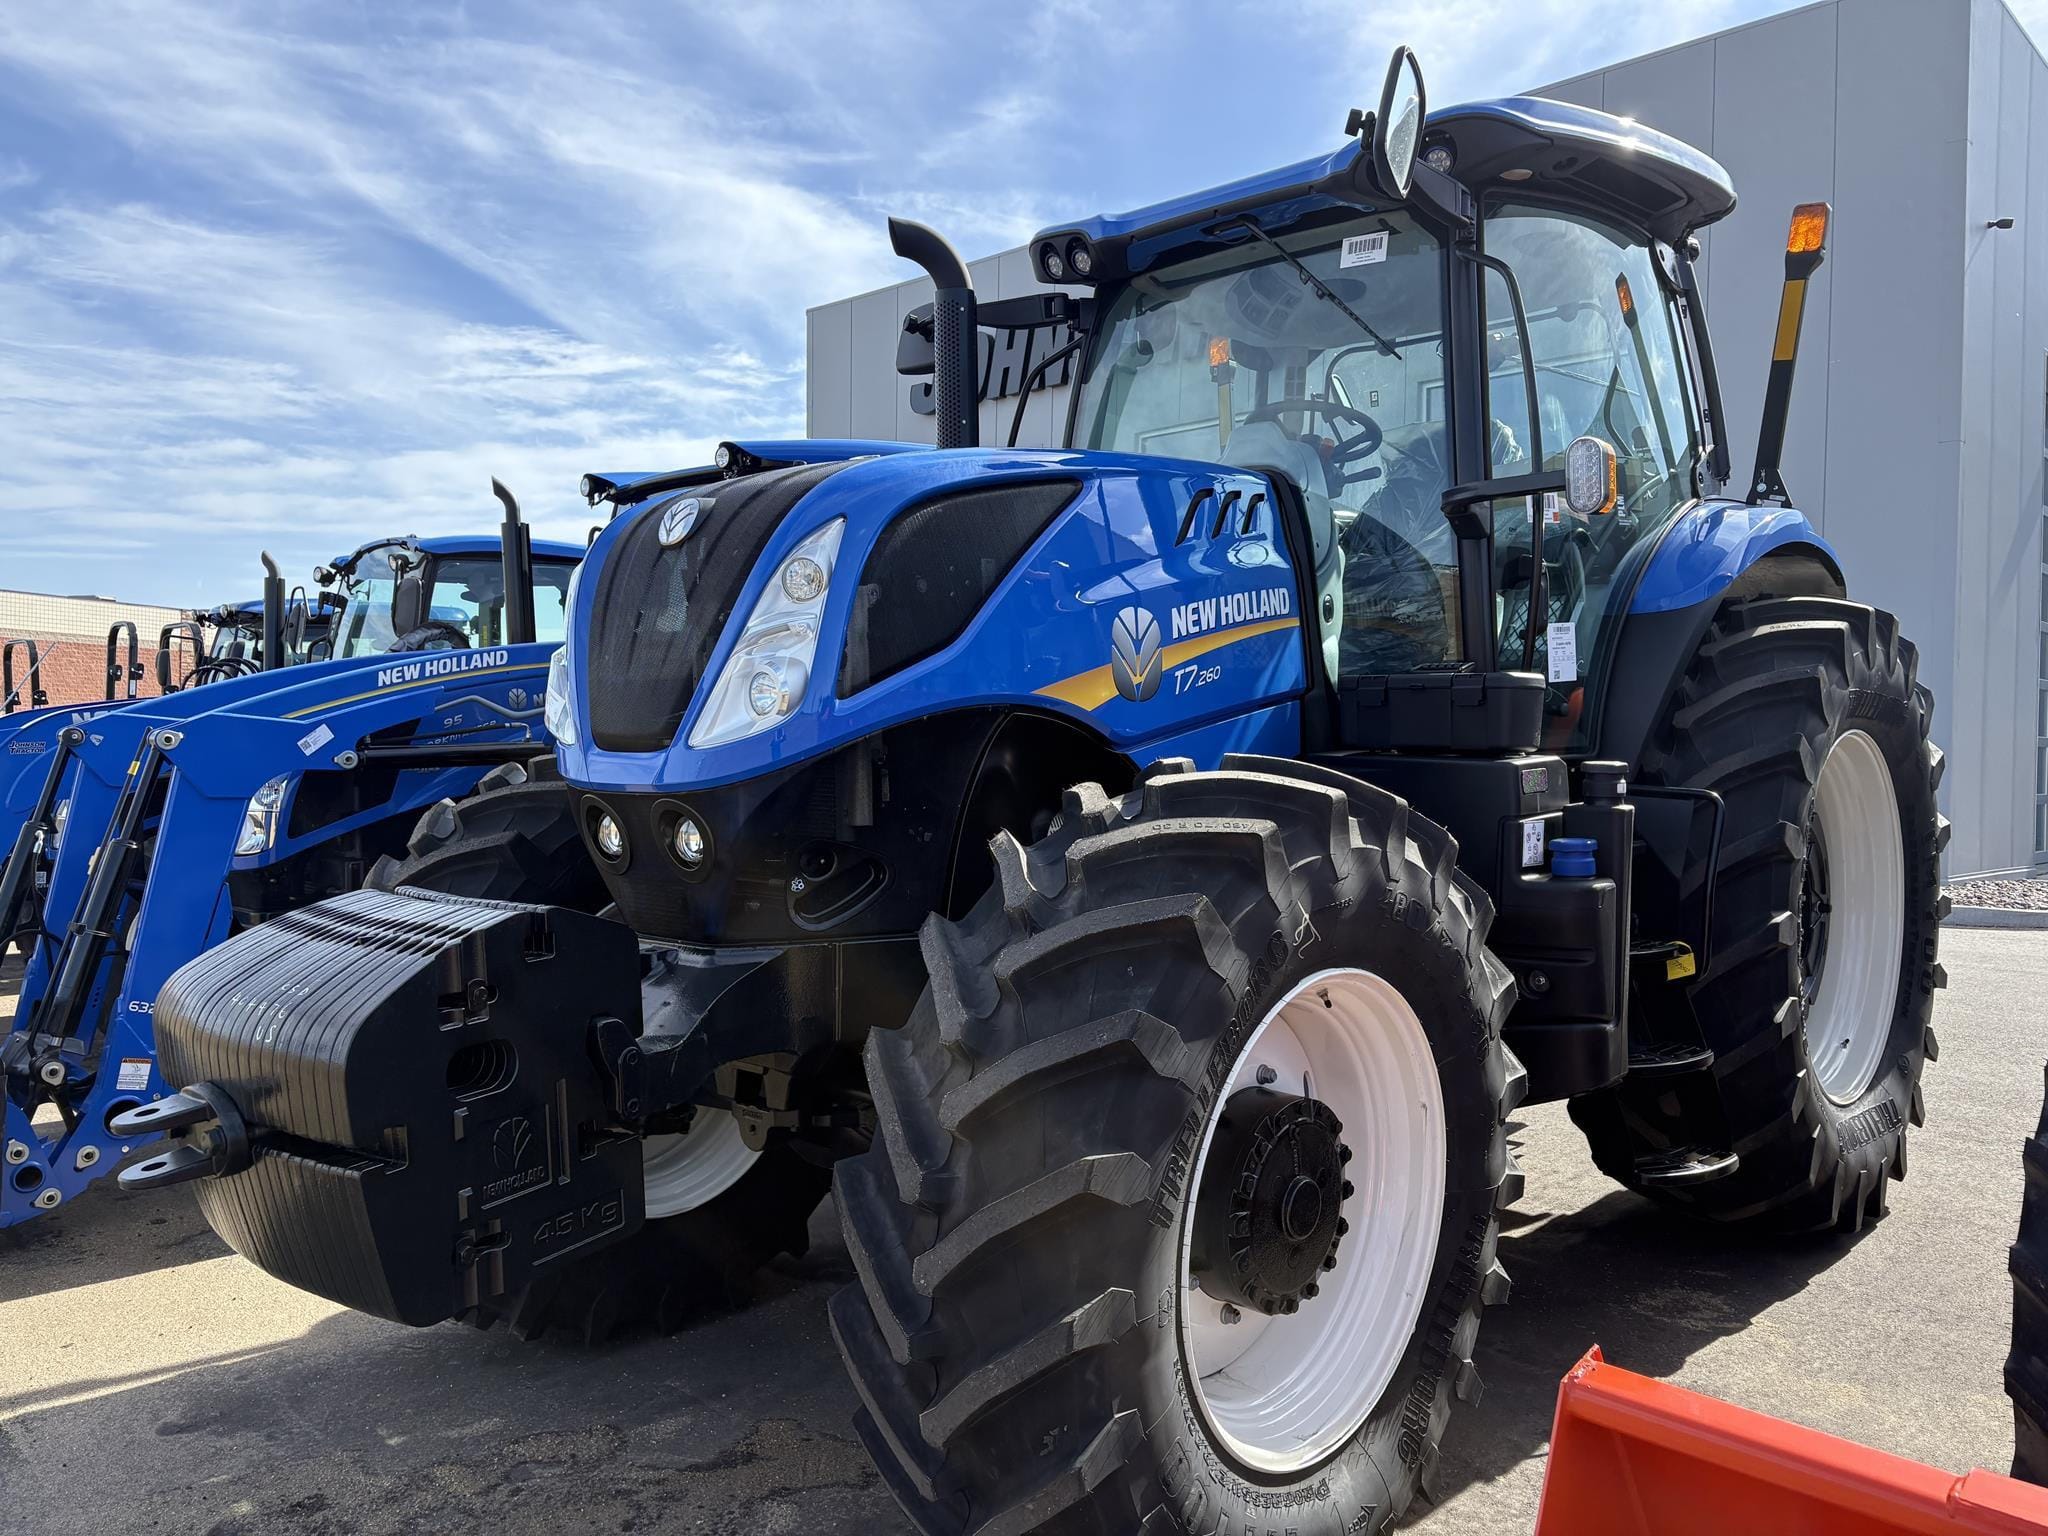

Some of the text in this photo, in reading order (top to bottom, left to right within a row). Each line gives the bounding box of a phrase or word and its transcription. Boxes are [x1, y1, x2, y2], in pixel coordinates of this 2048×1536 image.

[1171, 587, 1290, 639] NEW HOLLAND
[377, 650, 508, 687] NEW HOLLAND
[443, 714, 463, 728] 95
